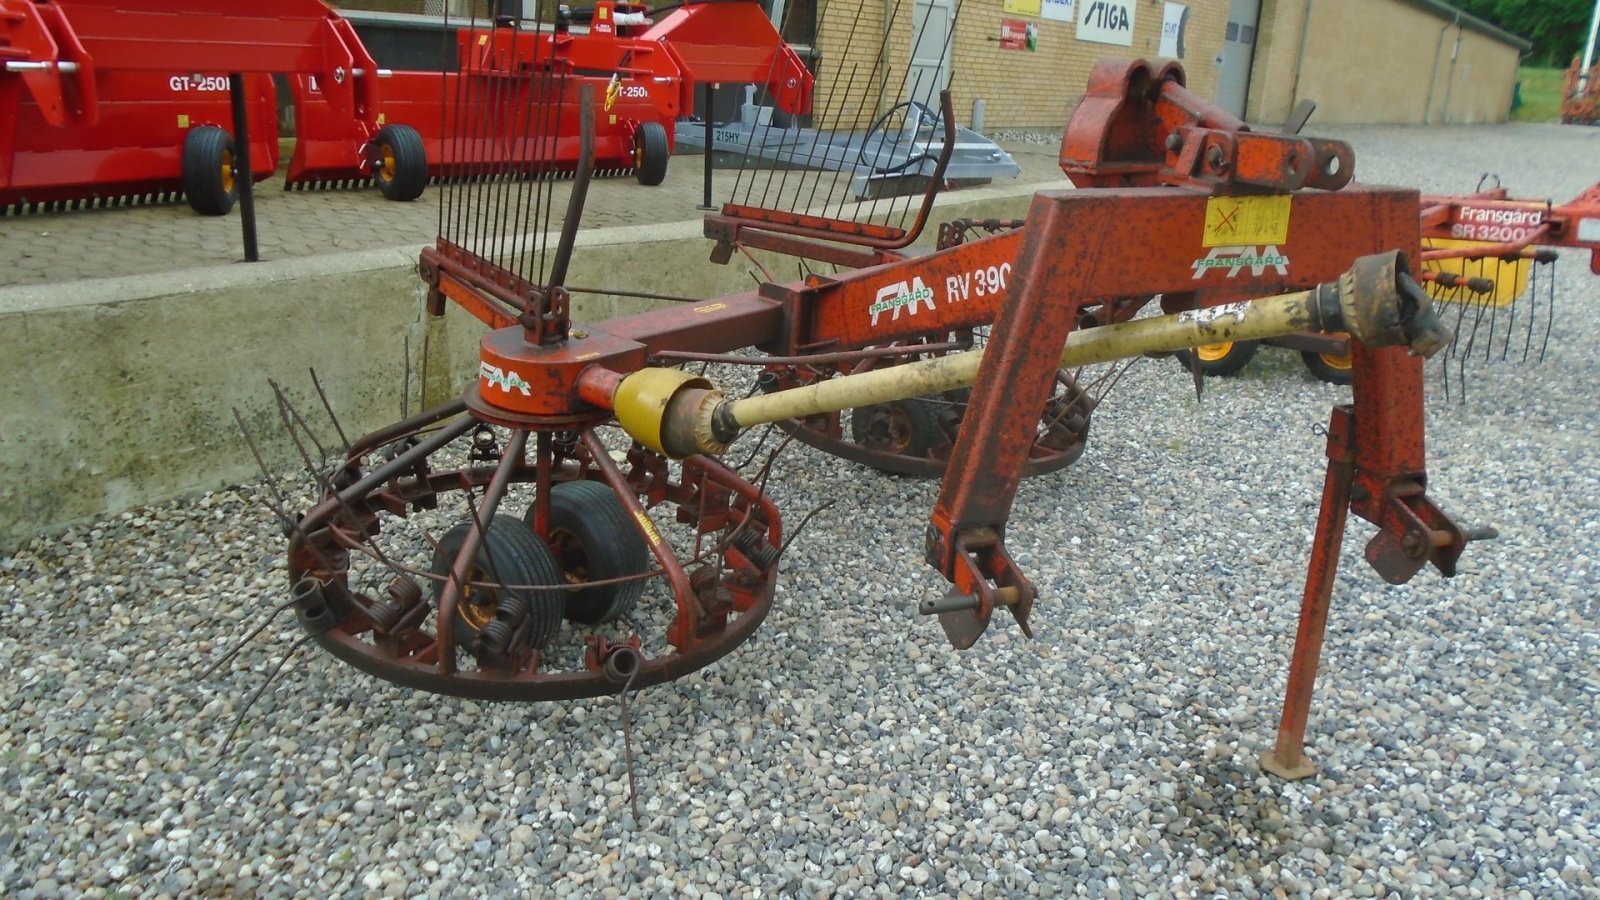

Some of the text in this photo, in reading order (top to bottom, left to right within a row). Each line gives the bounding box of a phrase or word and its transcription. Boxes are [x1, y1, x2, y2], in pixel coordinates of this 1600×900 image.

[1084, 0, 1130, 32] STIGA
[619, 86, 648, 97] T-250
[716, 129, 740, 144] 215HY
[1451, 223, 1476, 240] SR
[946, 262, 1011, 304] RV 390
